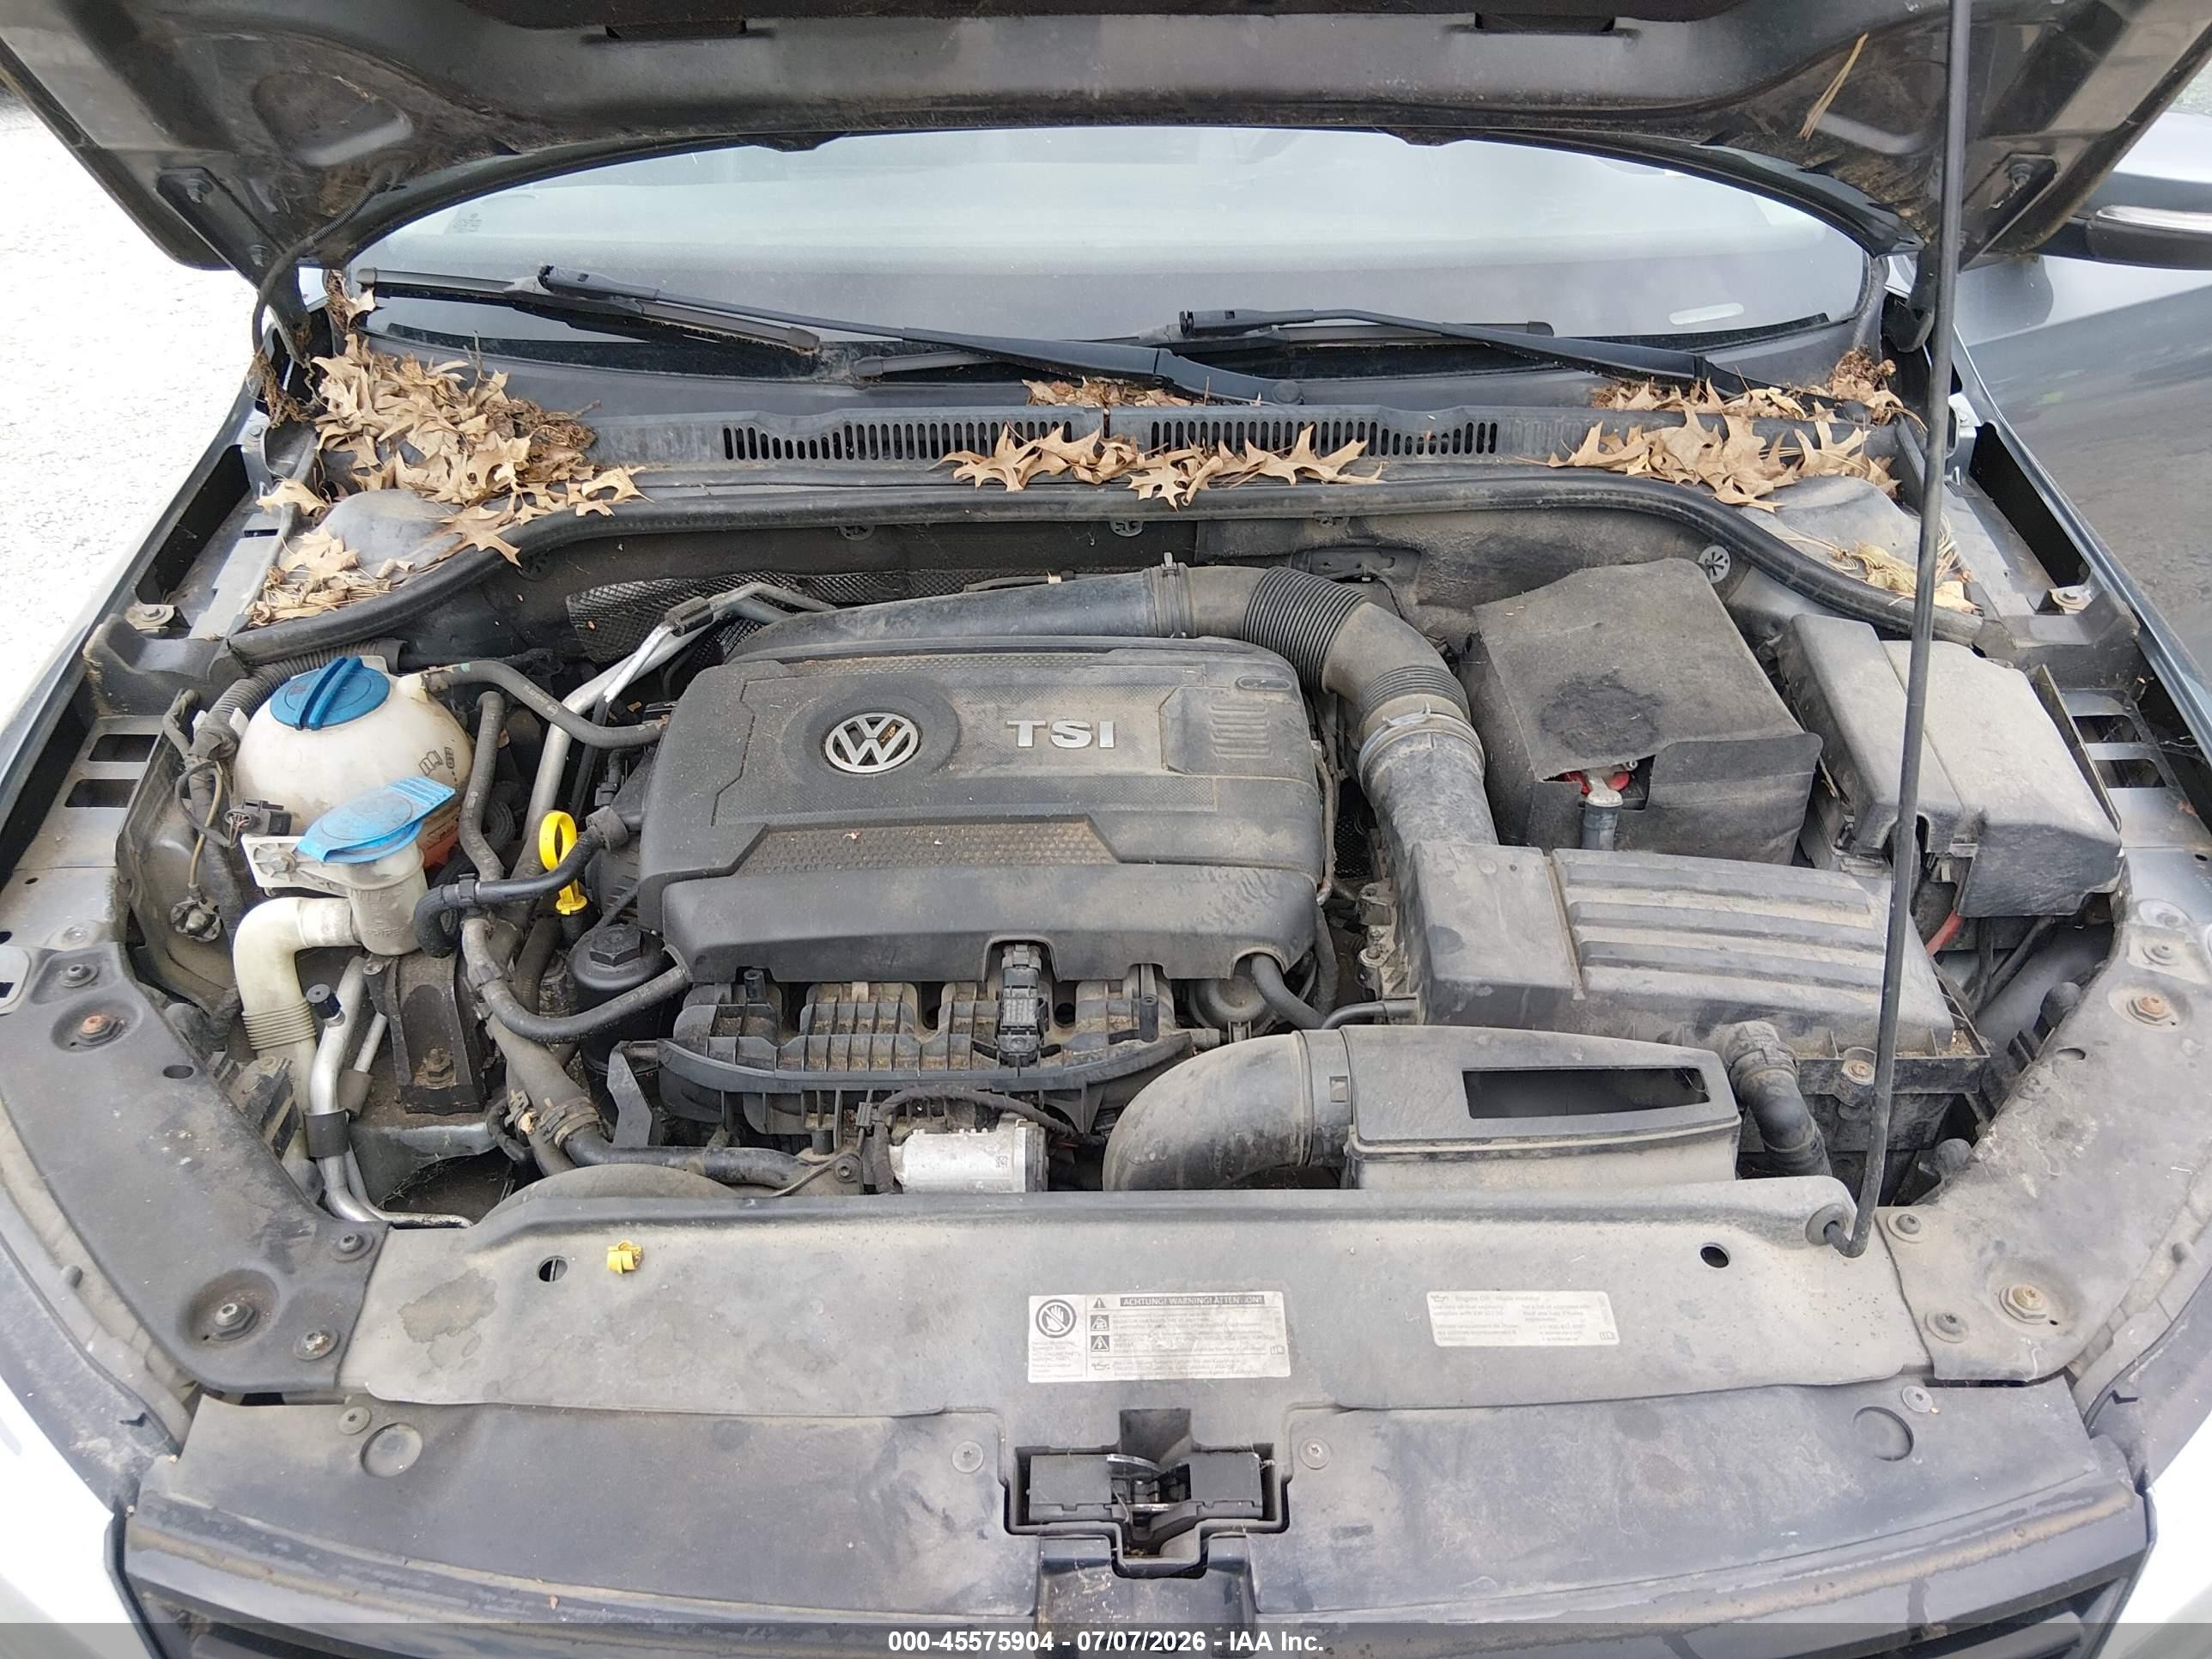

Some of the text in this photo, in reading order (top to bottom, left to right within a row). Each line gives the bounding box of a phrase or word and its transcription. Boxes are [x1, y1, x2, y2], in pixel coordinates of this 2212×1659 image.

[1006, 720, 1115, 749] TSI
[1123, 1297, 1167, 1306] ACHTUNG!
[1169, 1297, 1212, 1305] WARNING!
